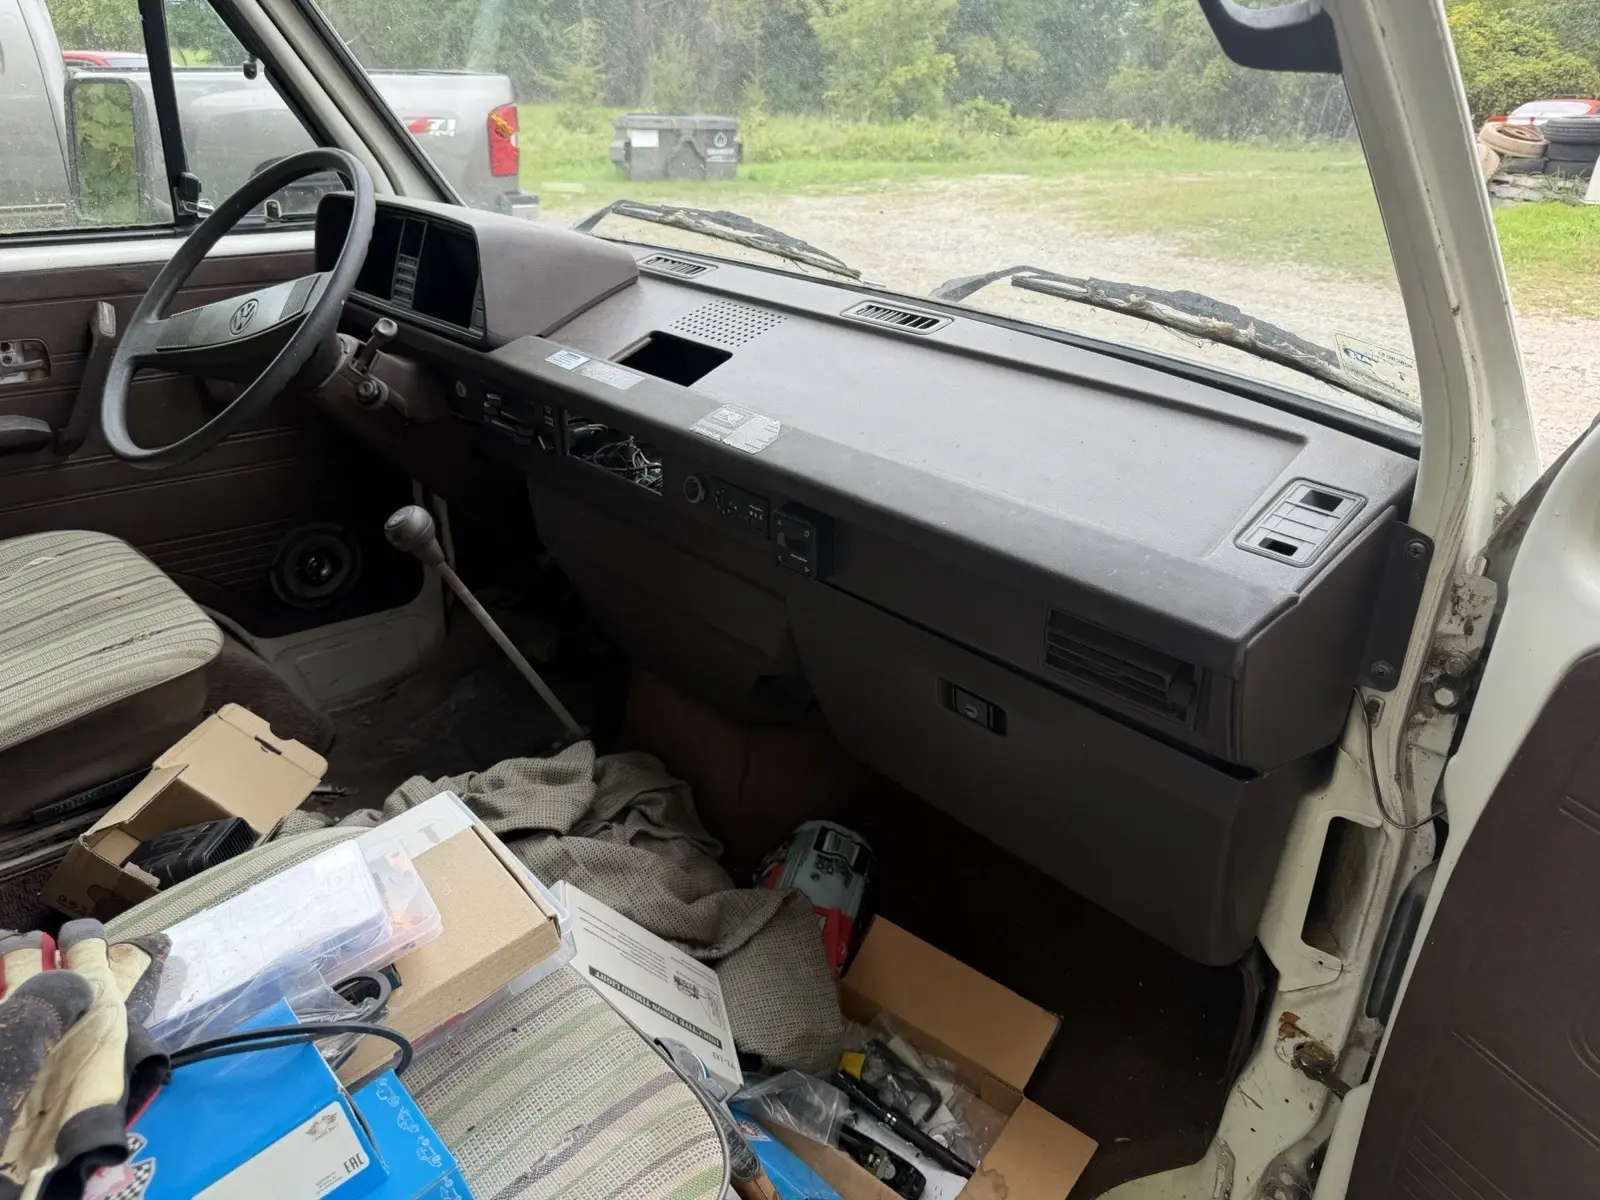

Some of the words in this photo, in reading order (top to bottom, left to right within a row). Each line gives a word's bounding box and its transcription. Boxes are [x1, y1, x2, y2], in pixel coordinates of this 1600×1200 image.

[594, 970, 621, 991] LIGHT
[622, 986, 651, 1008] TIMING
[343, 1152, 365, 1174] EAC
